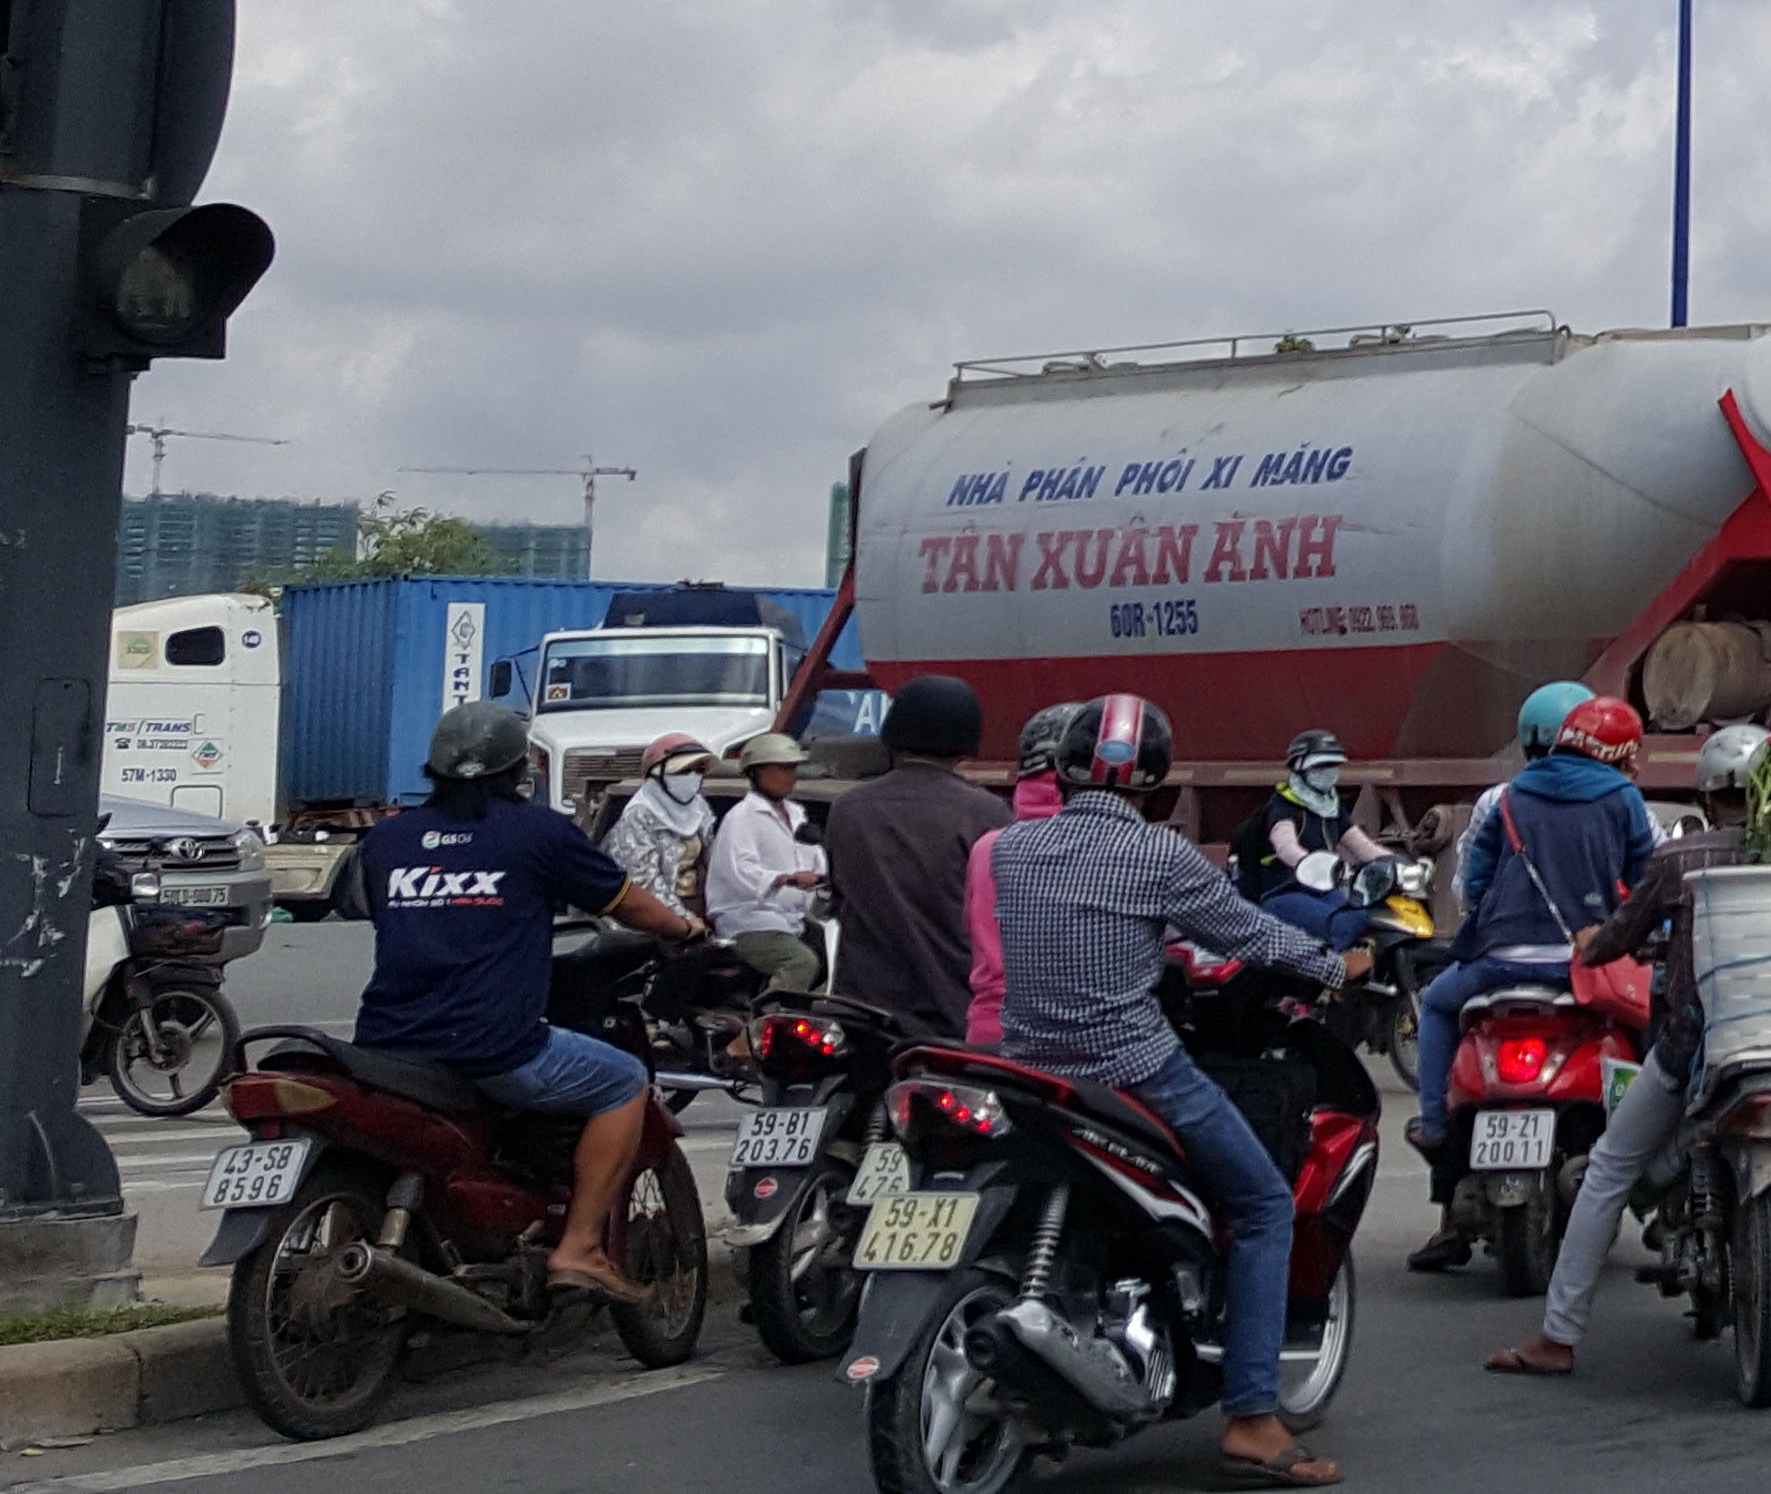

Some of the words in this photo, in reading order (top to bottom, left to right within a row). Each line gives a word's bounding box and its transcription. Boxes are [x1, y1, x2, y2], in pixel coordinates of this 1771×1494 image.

[1199, 455, 1243, 491] XI
[918, 520, 1025, 594] TÂN
[1030, 514, 1199, 591] XUÂN
[1110, 599, 1198, 639] 60R-1255
[388, 866, 506, 898] Kixx
[751, 1112, 810, 1136] 59-B1
[1486, 1114, 1539, 1139] 59-Z1
[223, 1146, 294, 1174] 43-S8
[735, 1138, 812, 1162] 203.76
[876, 1148, 903, 1173] 59
[213, 1174, 283, 1204] 8596
[884, 1198, 959, 1228] 59-X1
[863, 1231, 958, 1262] 416.78
